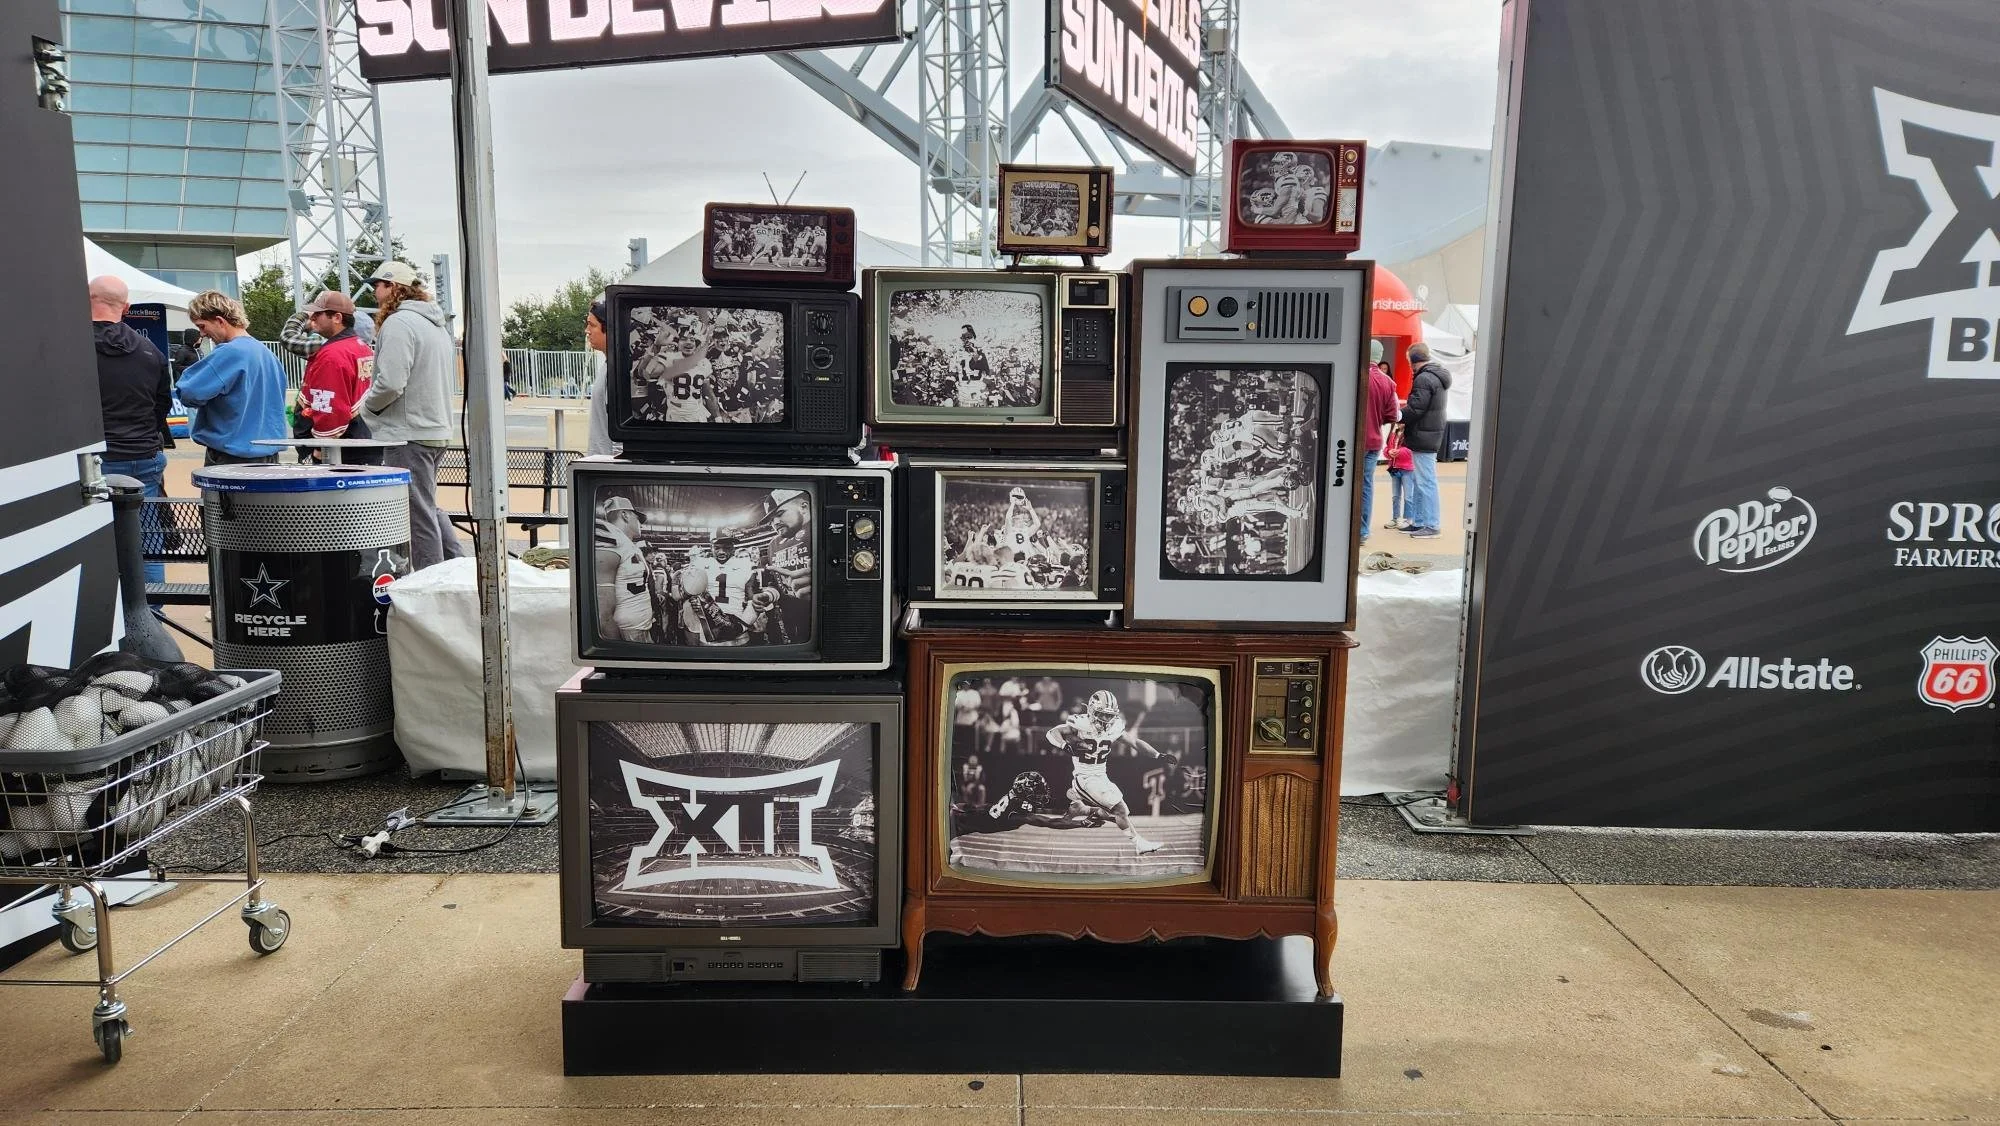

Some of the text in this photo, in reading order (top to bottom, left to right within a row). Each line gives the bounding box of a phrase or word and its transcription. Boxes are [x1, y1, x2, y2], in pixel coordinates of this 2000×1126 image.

[1062, 0, 1199, 158] SUN DEVILS
[673, 373, 706, 400] 89
[1738, 500, 1781, 535] Dr
[1694, 508, 1808, 566] Pepper
[714, 573, 729, 604] 1
[234, 613, 307, 625] RECYCLE
[247, 626, 291, 637] HERE
[1934, 648, 1988, 662] PHILLIPS
[1706, 656, 1854, 691] Allstate
[1932, 667, 1982, 695] 66
[1077, 739, 1112, 765] 22
